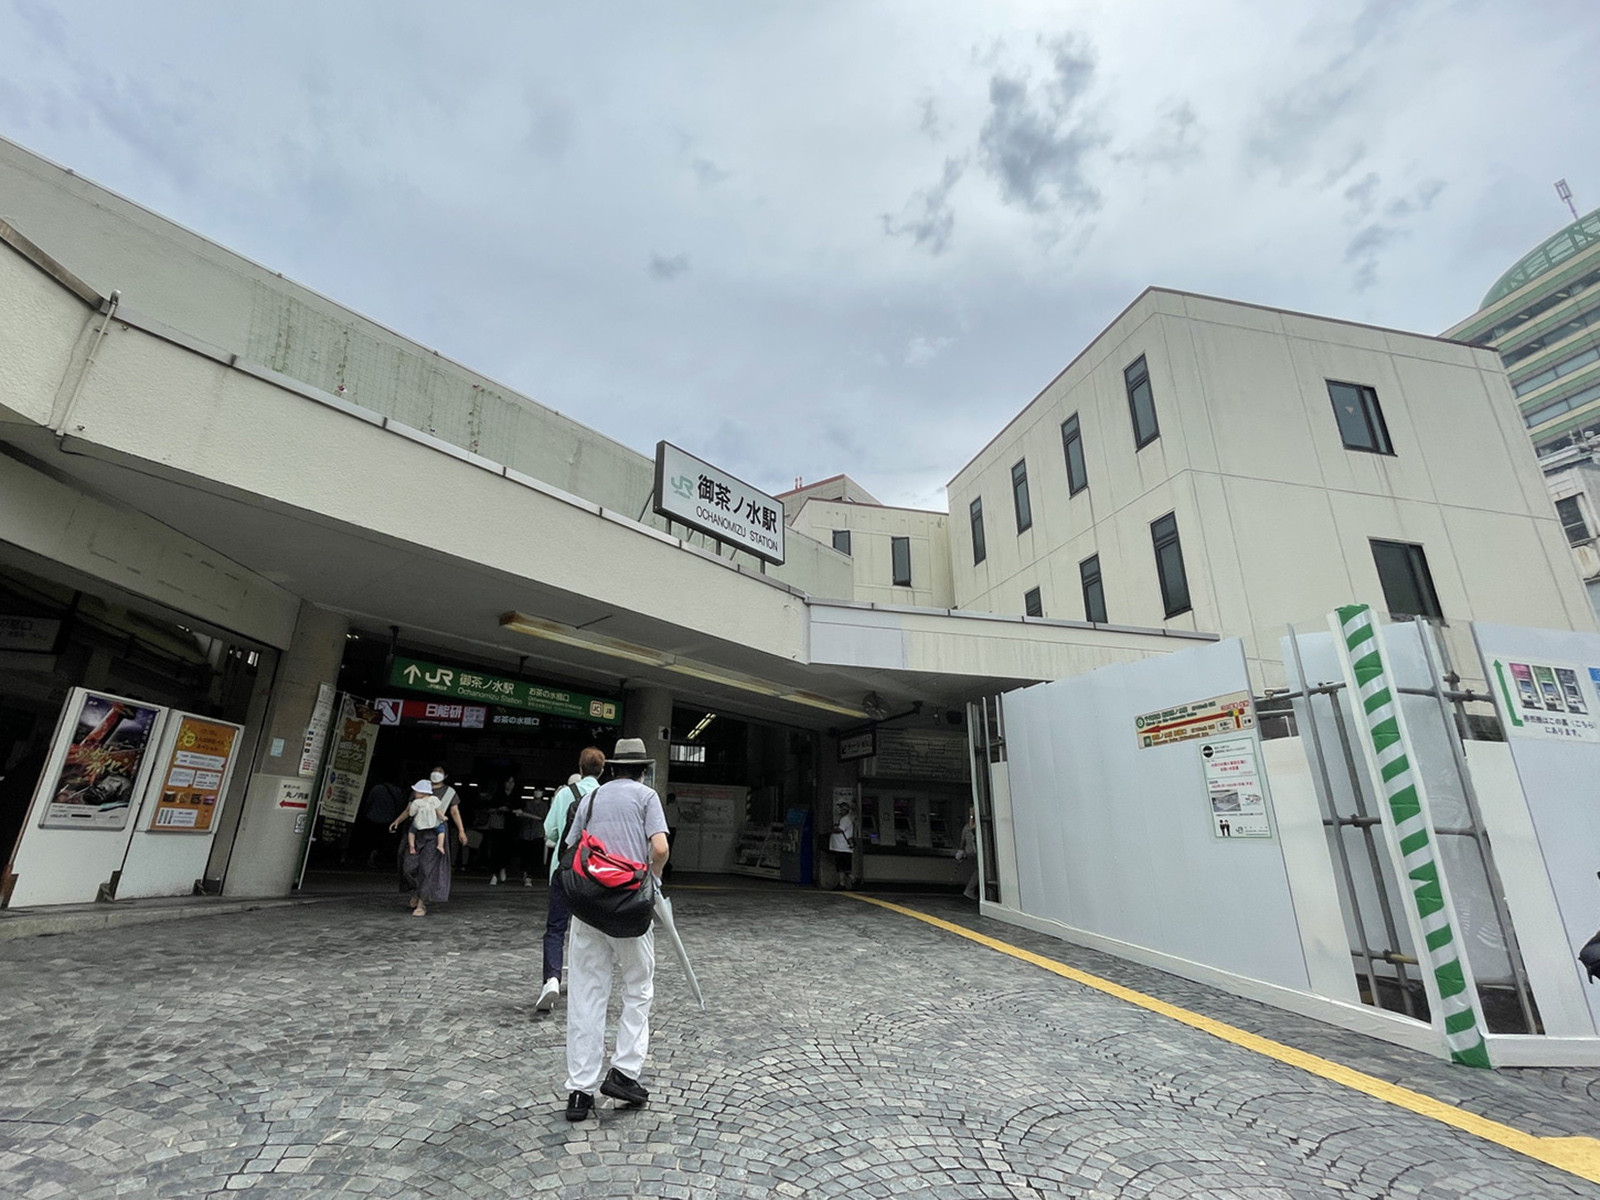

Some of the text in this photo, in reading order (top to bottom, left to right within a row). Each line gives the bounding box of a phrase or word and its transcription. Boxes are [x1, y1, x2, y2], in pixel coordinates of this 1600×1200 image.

[671, 475, 694, 499] JR
[697, 474, 777, 534] 御茶ノ水駅
[696, 506, 778, 552] OCHANOMIZU STATION
[425, 668, 454, 686] JR
[459, 673, 515, 695] 御茶ノ水駅
[457, 687, 523, 705] Ochanomizu Station
[529, 687, 570, 702] お茶の水橋口
[425, 703, 463, 719] 日能研
